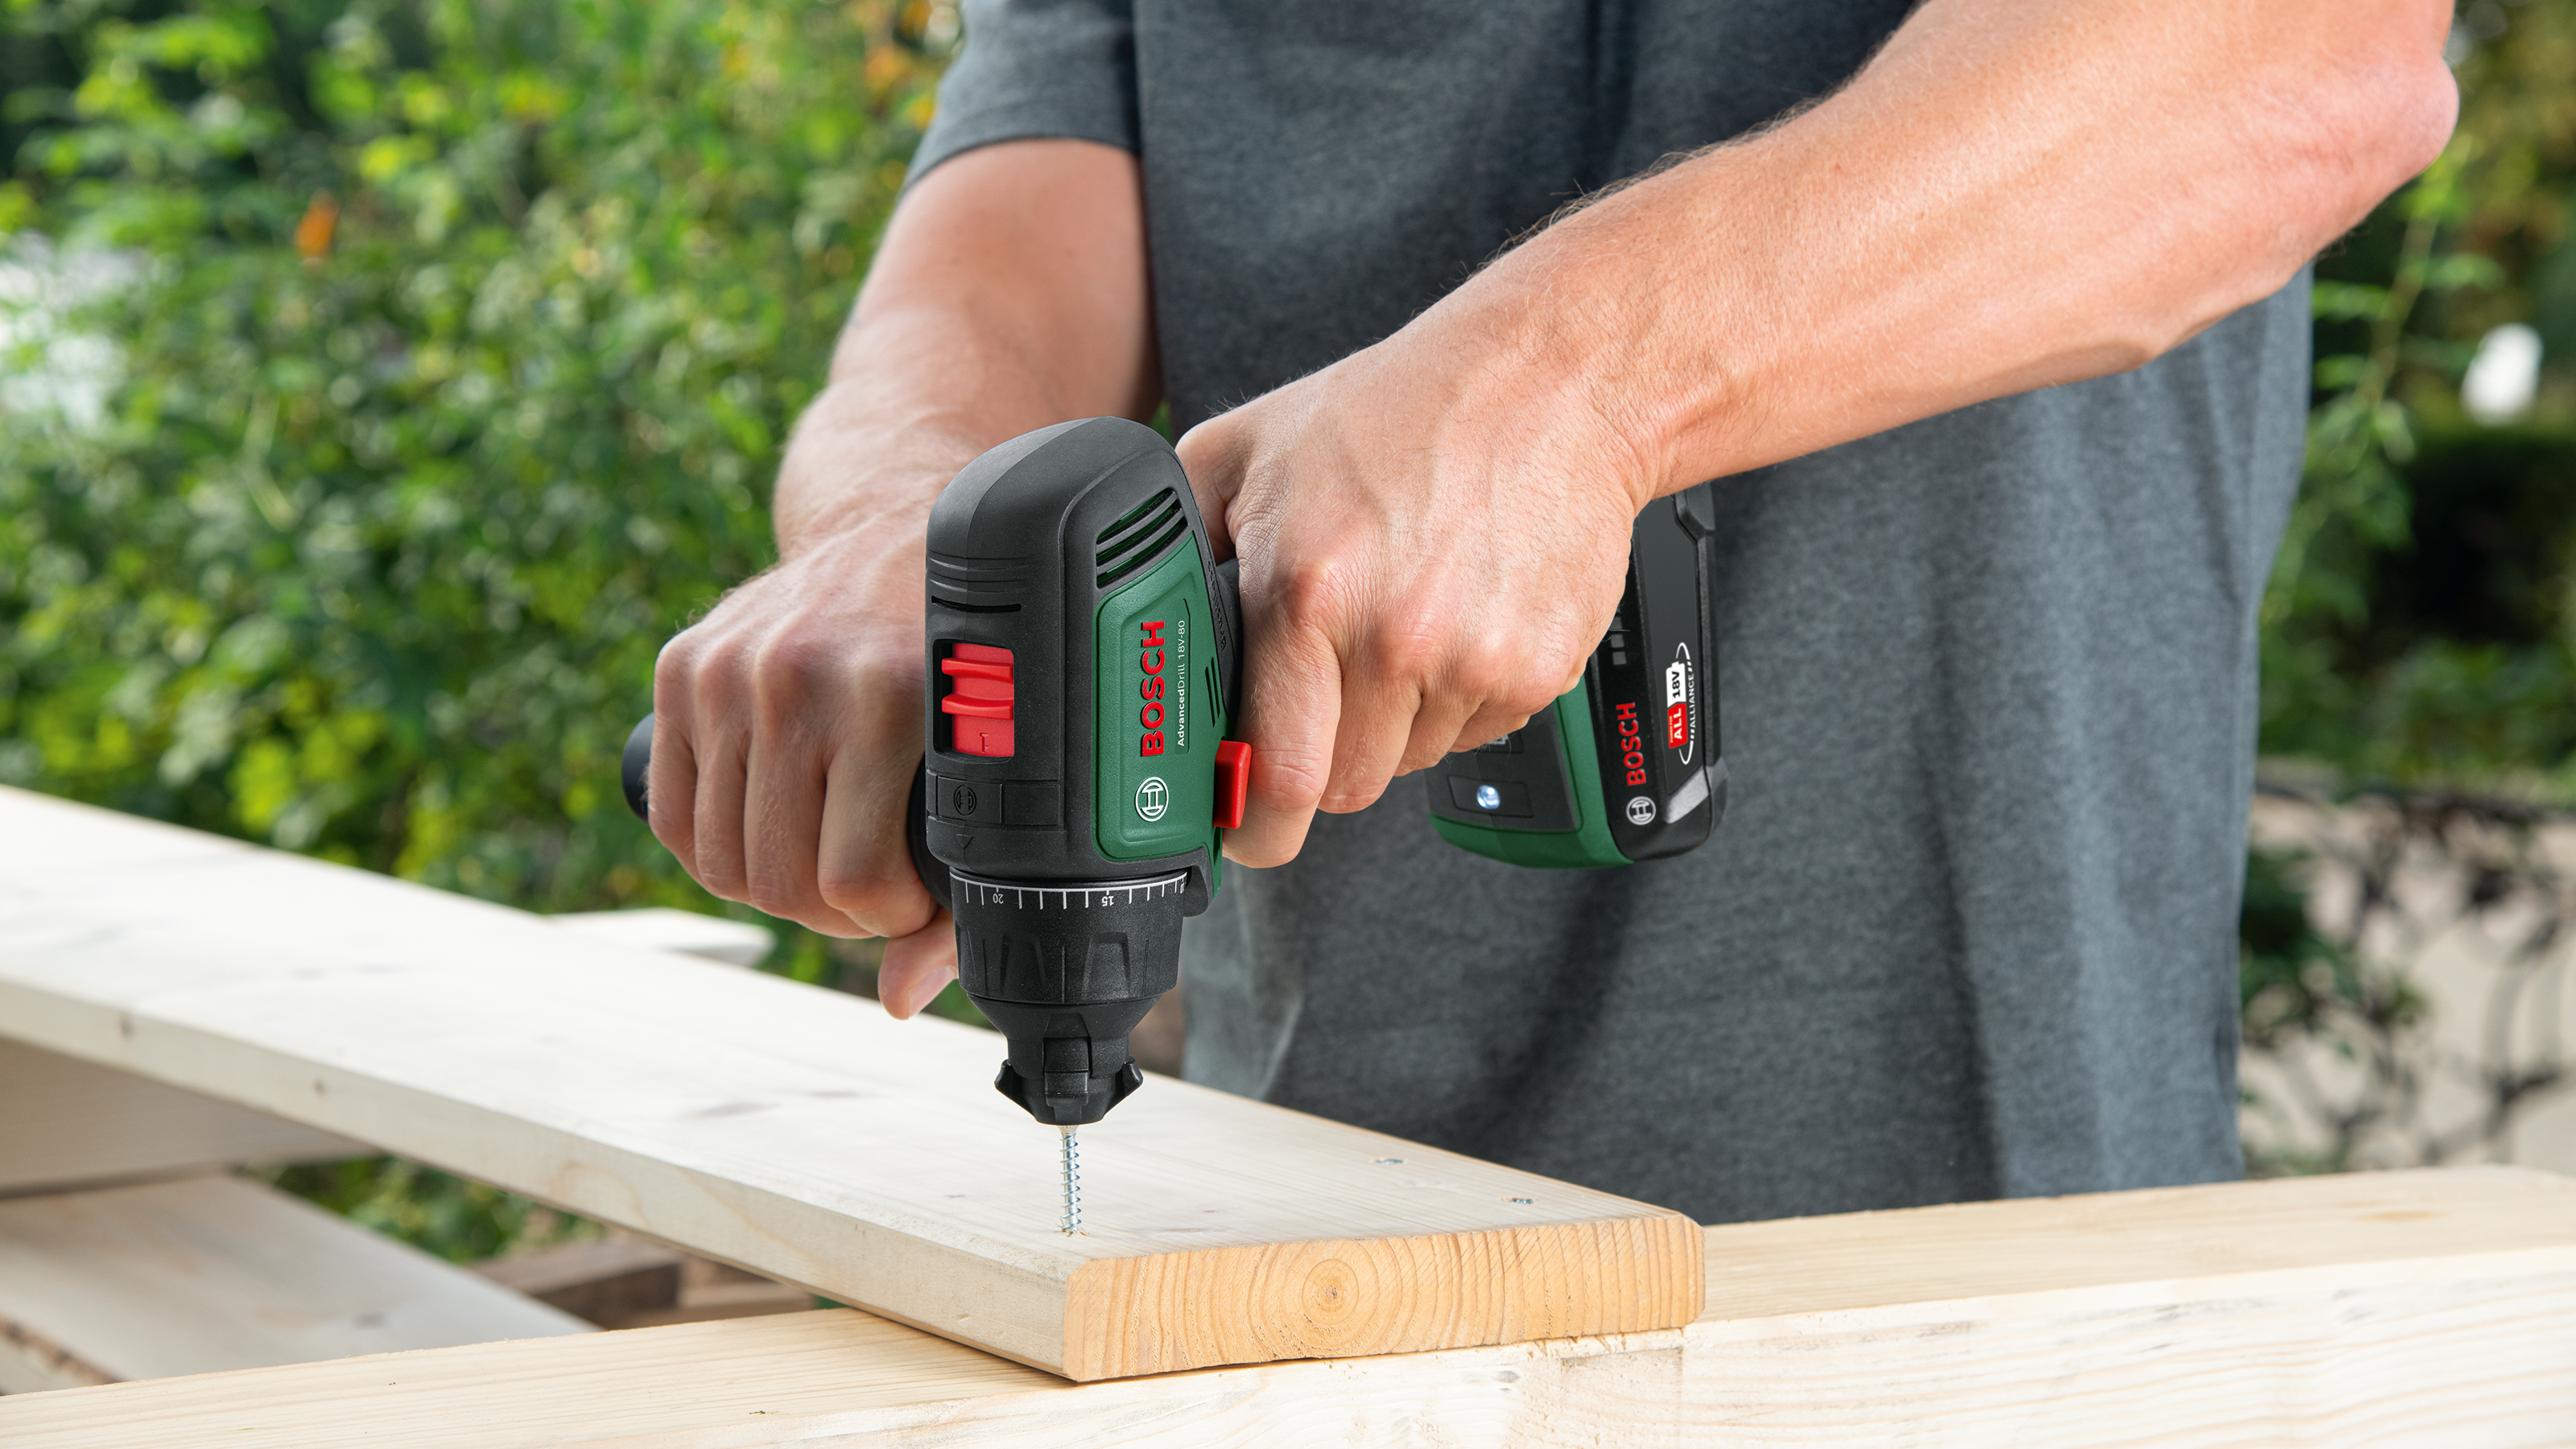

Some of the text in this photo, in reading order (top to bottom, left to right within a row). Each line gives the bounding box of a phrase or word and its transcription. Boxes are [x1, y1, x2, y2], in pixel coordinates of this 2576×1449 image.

[1141, 621, 1165, 757] BOSCH
[1672, 671, 1682, 740] ALL 18V
[1688, 673, 1696, 728] ALLIANCE
[1616, 702, 1646, 786] BOSCH
[993, 893, 1114, 907] 20 15
